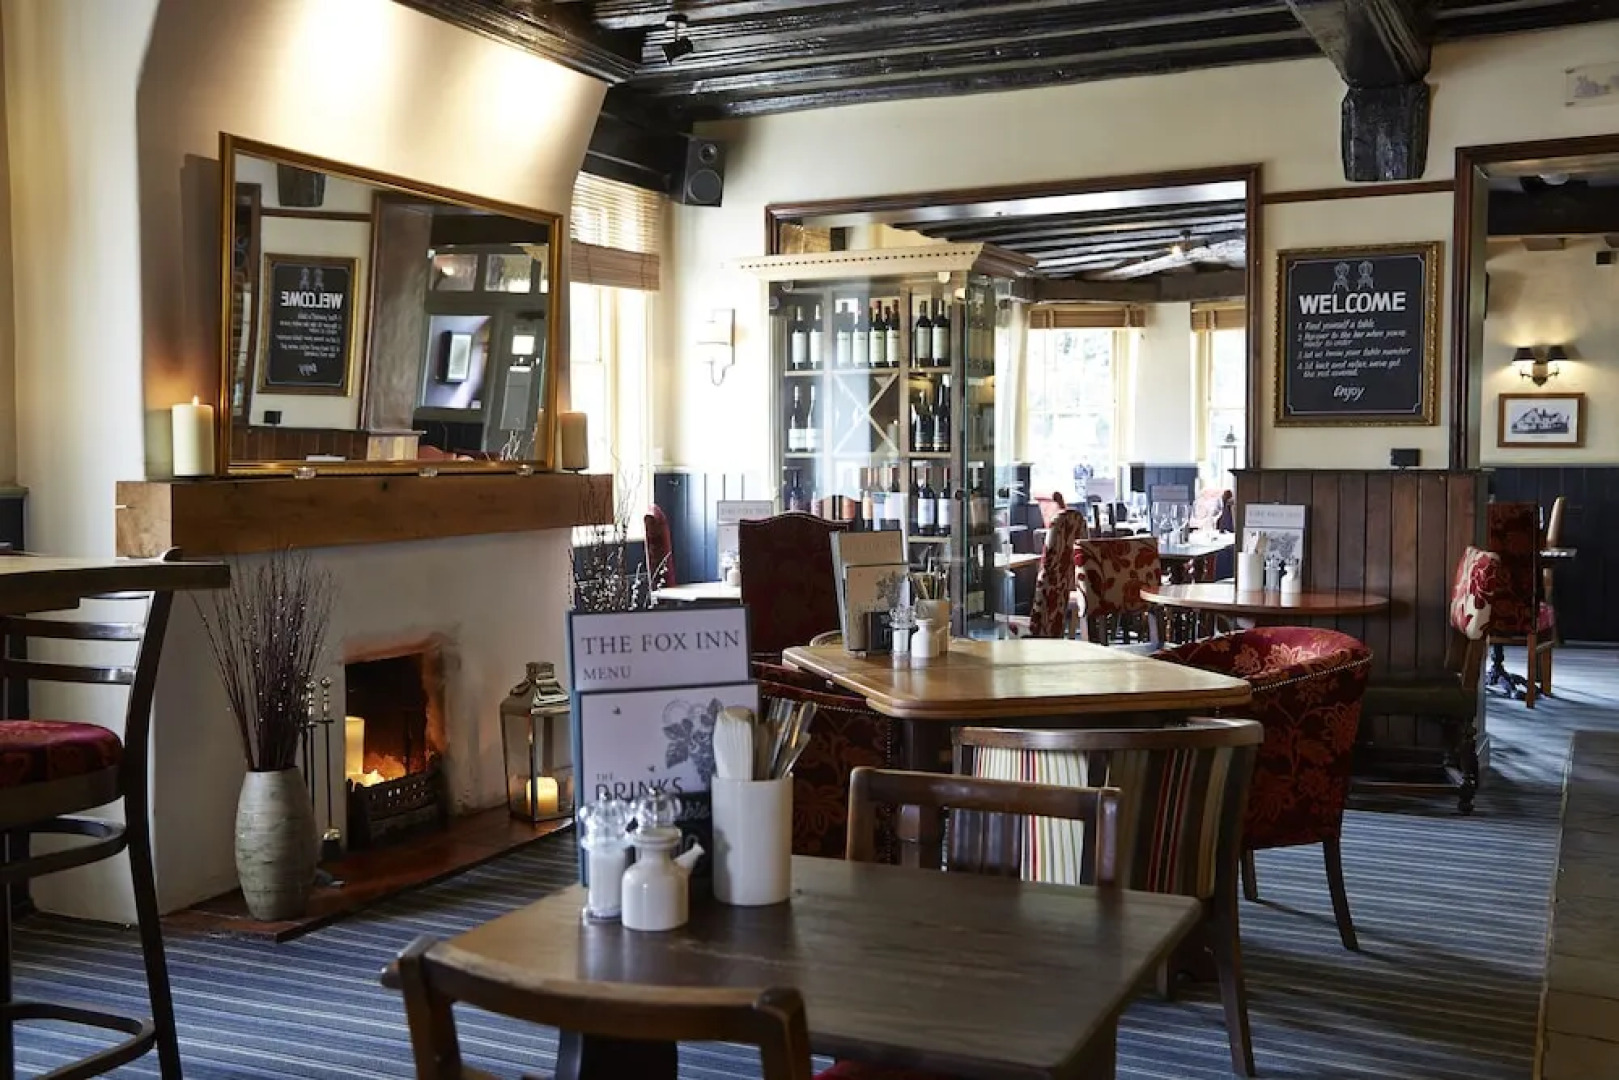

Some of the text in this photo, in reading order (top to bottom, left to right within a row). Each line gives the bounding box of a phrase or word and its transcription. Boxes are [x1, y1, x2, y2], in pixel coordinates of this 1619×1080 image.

[1299, 291, 1406, 315] WELCOME
[1362, 347, 1381, 357] table
[1333, 384, 1366, 402] Enjoy
[581, 629, 740, 655] THE FOX INN
[582, 665, 632, 681] MENU
[595, 776, 684, 802] DRINKS
